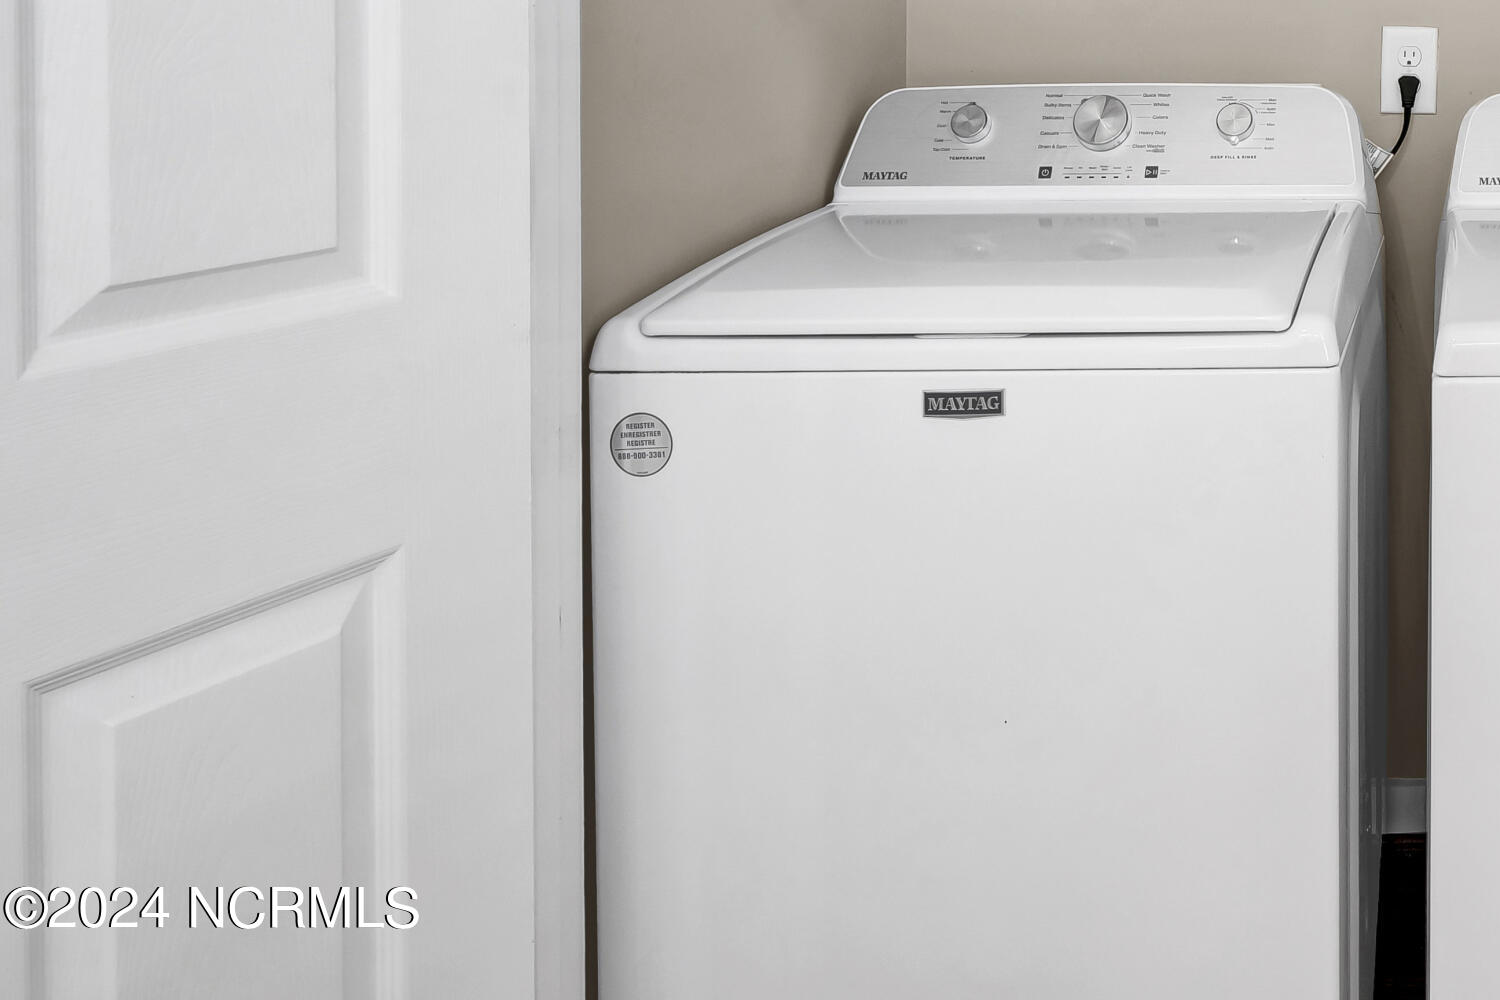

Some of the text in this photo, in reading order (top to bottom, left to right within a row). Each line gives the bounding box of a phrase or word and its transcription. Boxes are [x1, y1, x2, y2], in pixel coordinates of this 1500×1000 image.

[862, 171, 908, 180] MAYTAG
[927, 396, 1000, 411] MAYTAG
[625, 422, 655, 430] REGISTER
